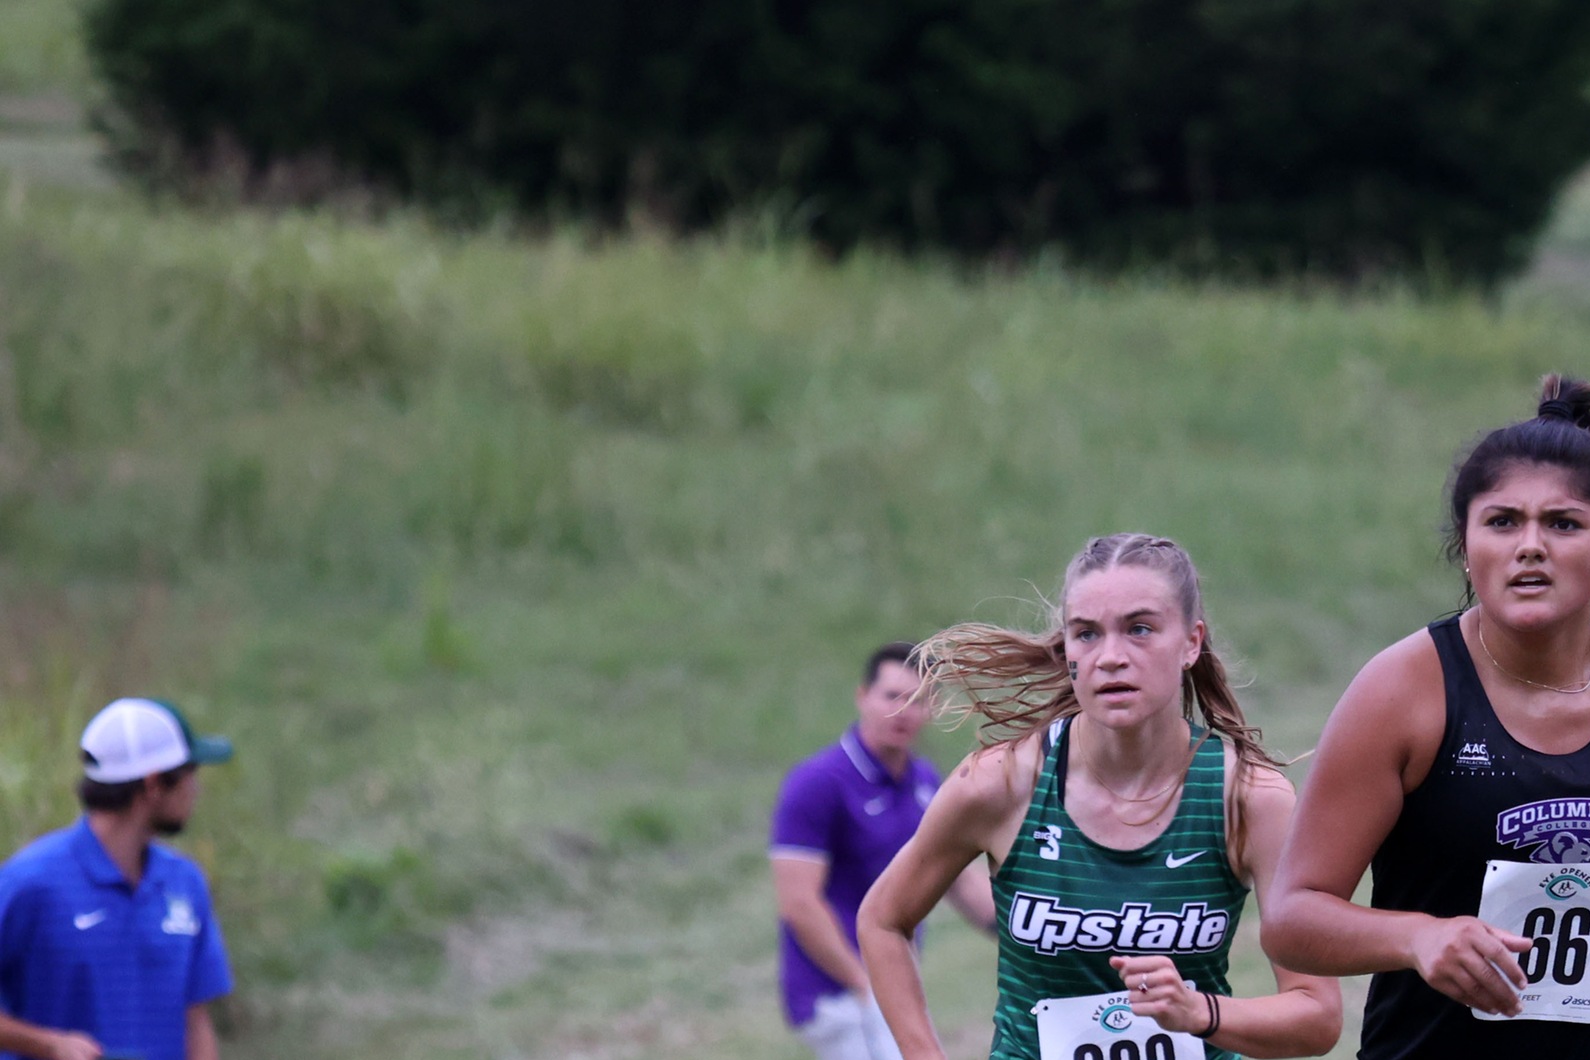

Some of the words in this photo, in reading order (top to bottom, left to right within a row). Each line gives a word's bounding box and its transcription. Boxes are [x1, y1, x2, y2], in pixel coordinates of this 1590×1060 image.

[1463, 743, 1486, 754] AAC
[1538, 872, 1556, 888] EYE
[1010, 891, 1230, 956] Upstate
[1091, 1004, 1105, 1021] EYE
